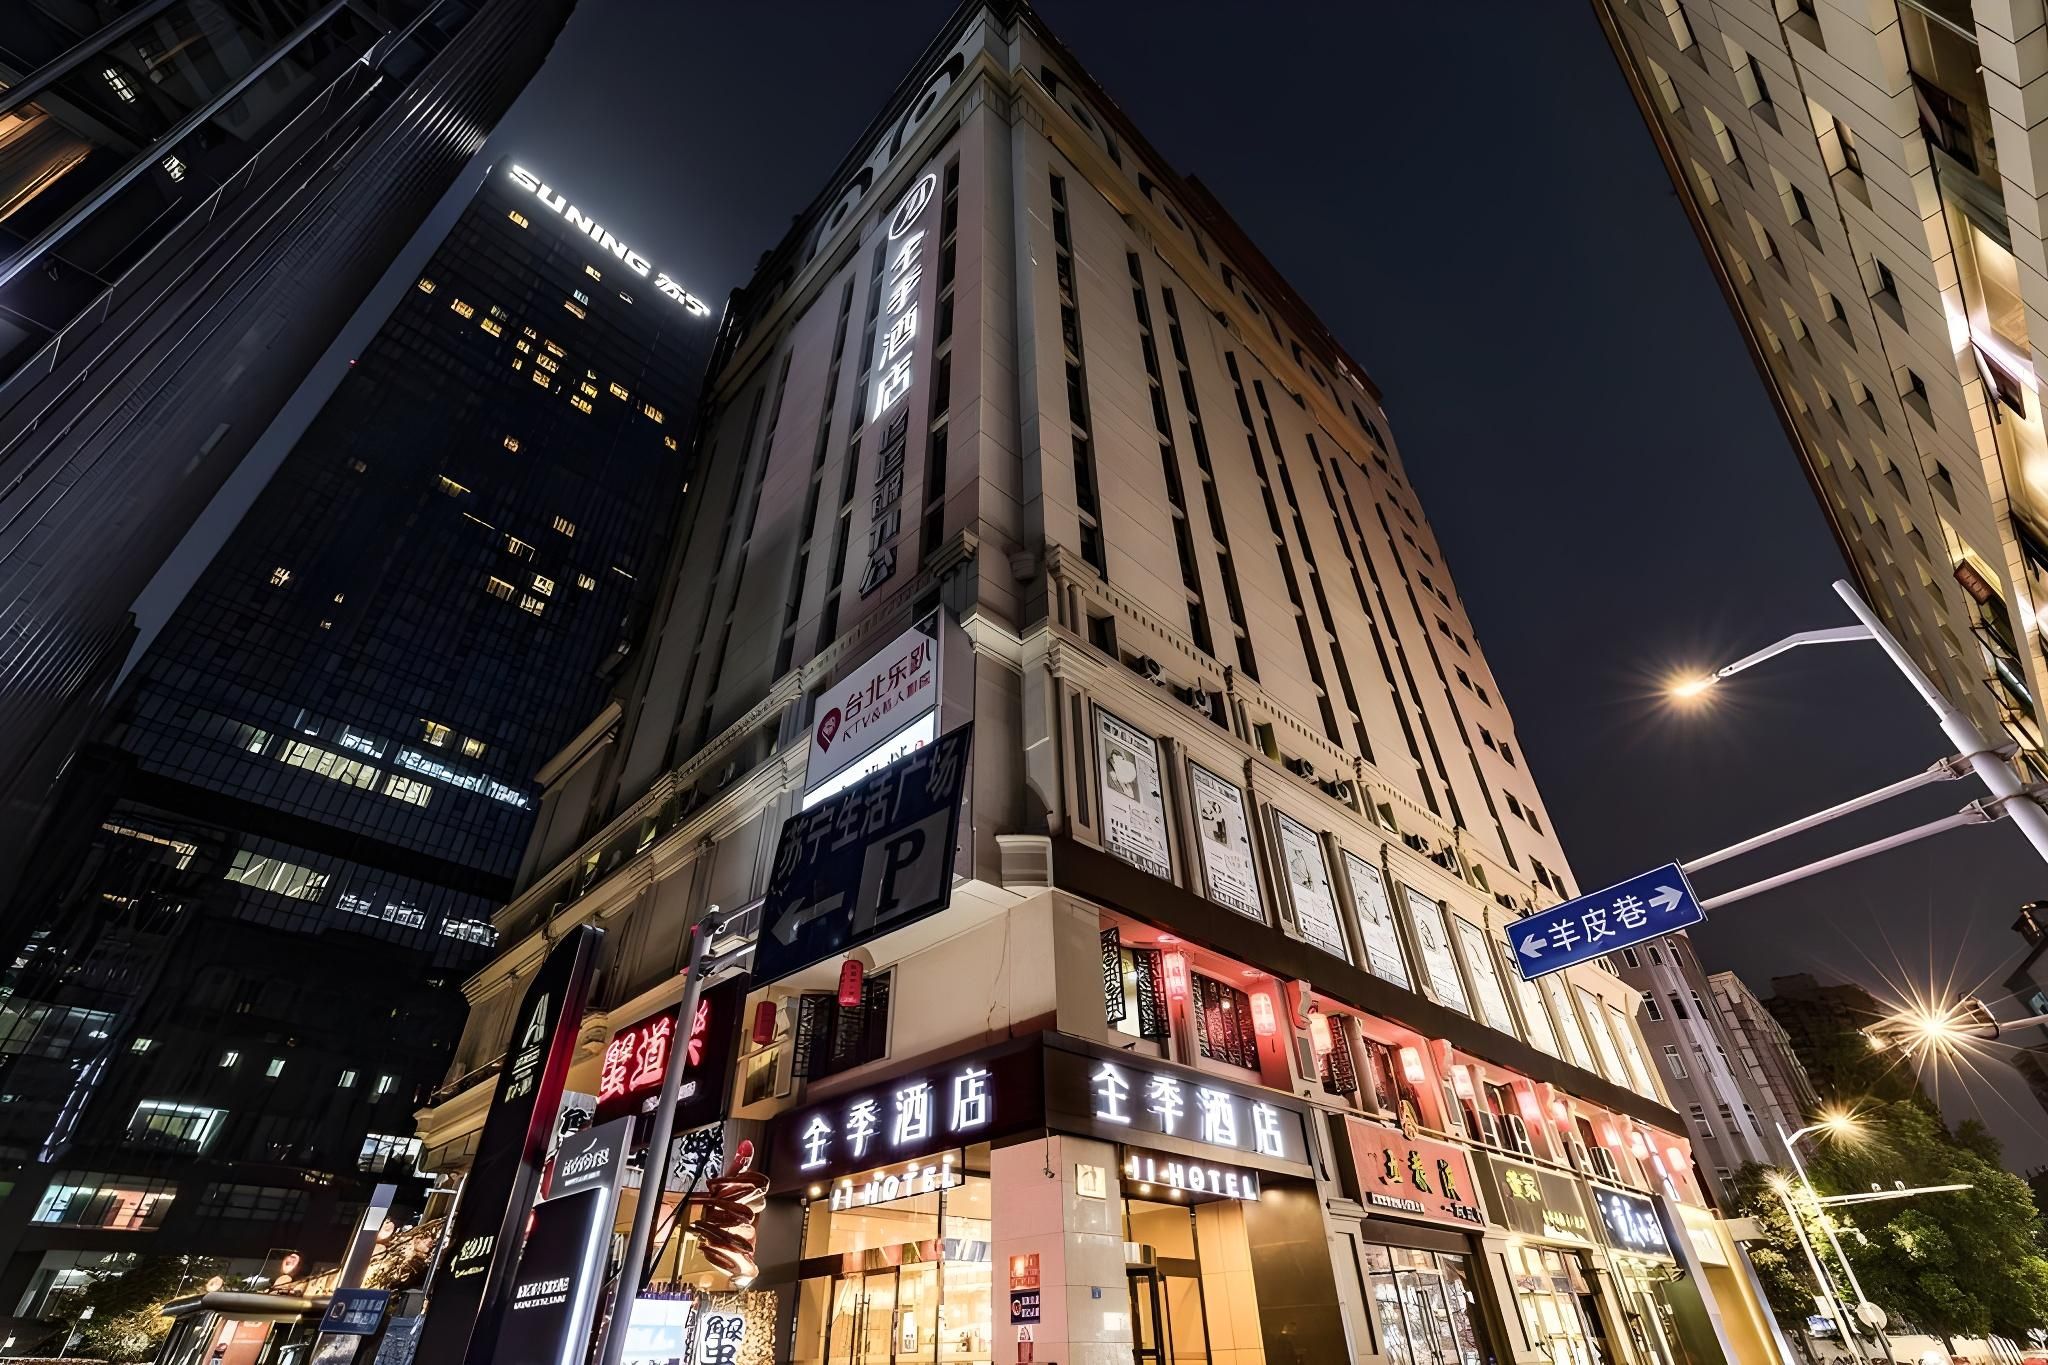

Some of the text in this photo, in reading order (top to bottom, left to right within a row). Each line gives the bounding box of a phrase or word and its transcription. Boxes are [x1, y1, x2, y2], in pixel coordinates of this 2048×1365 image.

[508, 163, 652, 278] SUNING
[872, 228, 926, 424] 全季酒店
[844, 639, 931, 722] 台北乐趴
[778, 737, 960, 880] 苏宁生活广场
[877, 827, 926, 914] P
[1547, 895, 1648, 952] 羊皮巷
[800, 1067, 991, 1171] 全季酒店
[1092, 1062, 1285, 1158] 全季酒店
[863, 1163, 956, 1205] HOTEL
[1167, 1162, 1257, 1200] HOTEL
